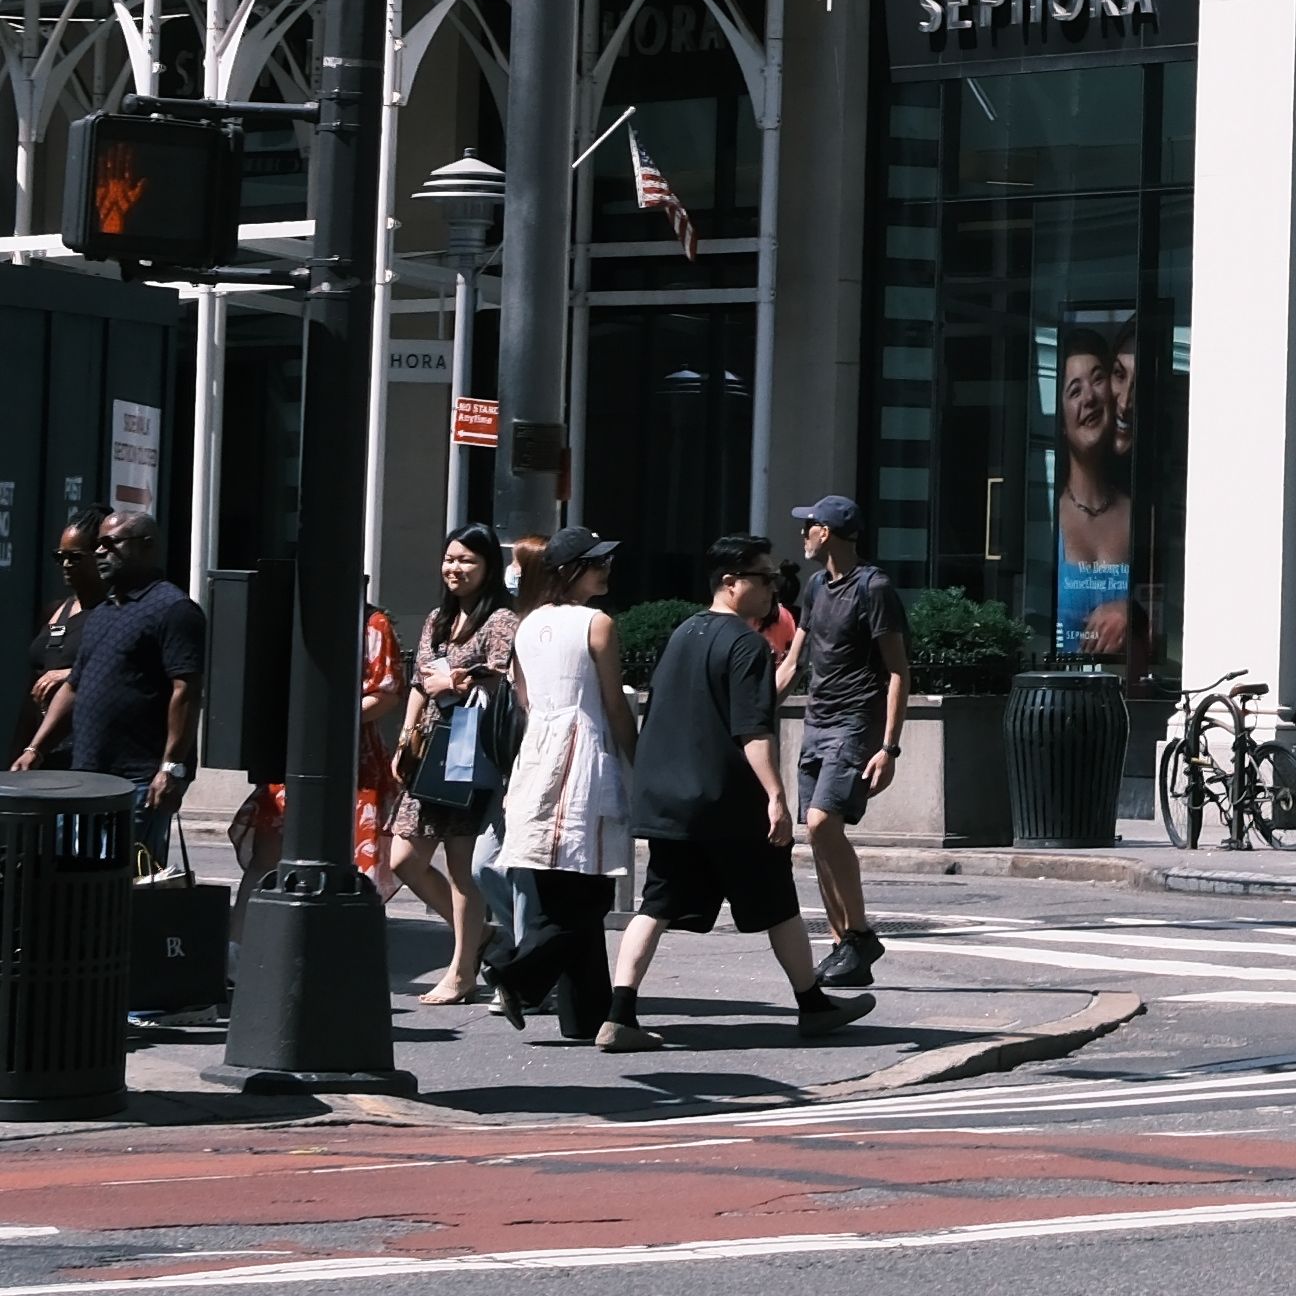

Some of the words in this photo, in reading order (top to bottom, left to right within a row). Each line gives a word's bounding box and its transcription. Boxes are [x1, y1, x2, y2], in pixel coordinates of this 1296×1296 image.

[1079, 560, 1091, 574] We
[1092, 560, 1119, 576] Belong
[1064, 576, 1106, 592] Something
[1066, 630, 1099, 640] SEPHORA
